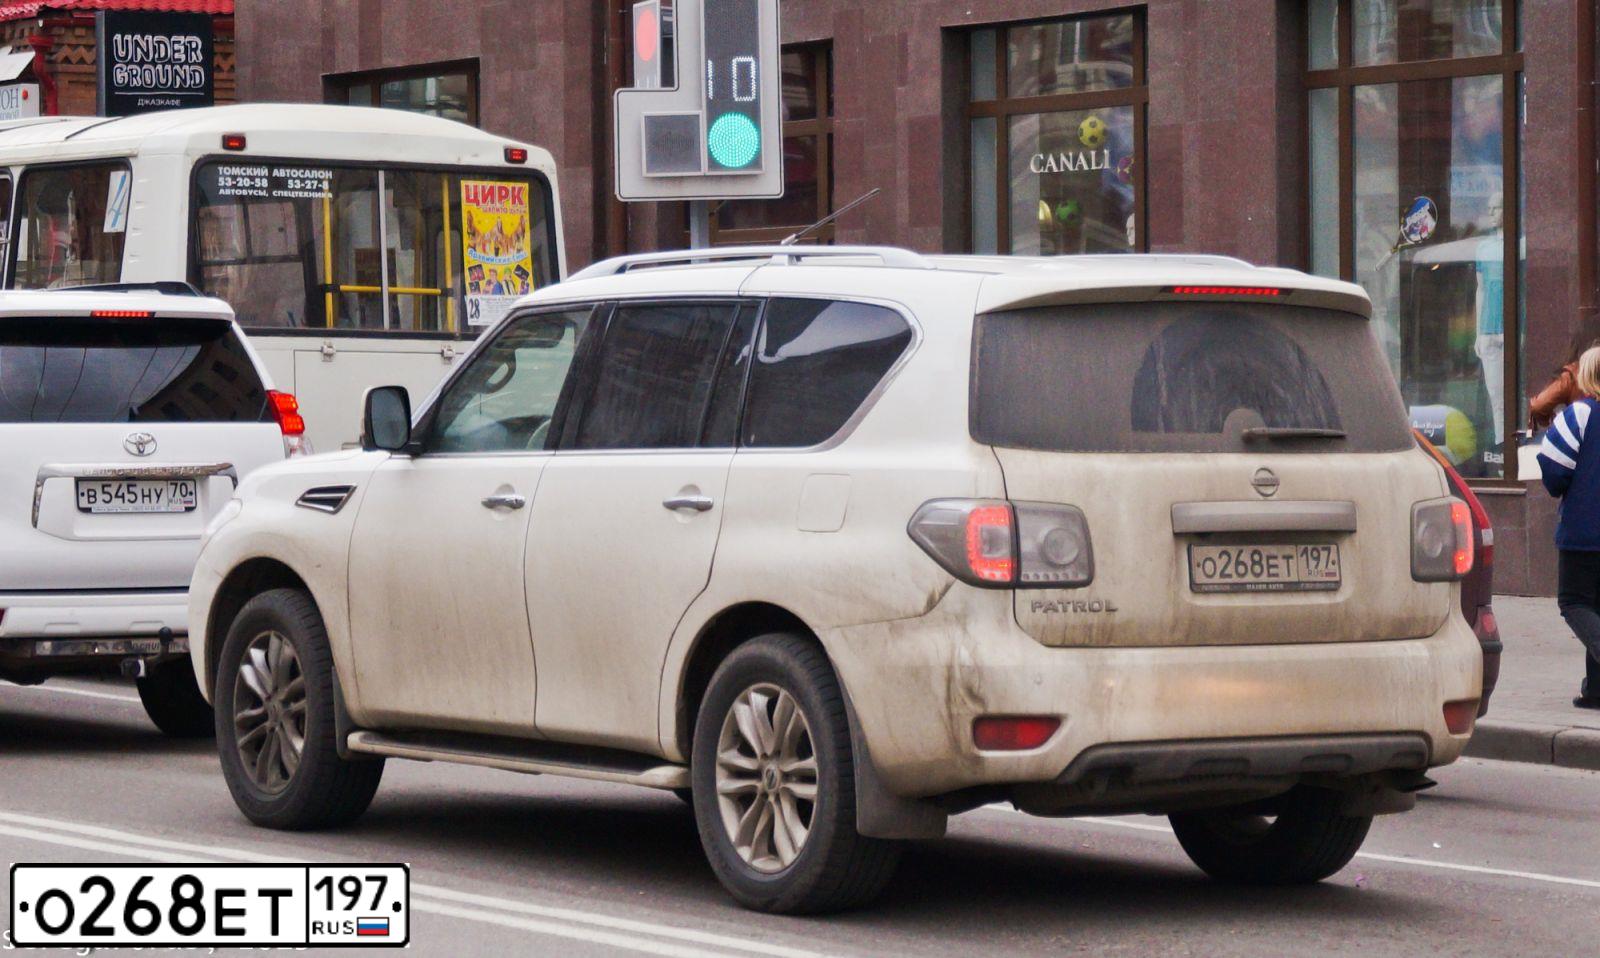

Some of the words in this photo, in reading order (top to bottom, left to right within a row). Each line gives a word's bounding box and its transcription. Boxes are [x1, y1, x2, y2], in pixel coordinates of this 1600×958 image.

[113, 33, 203, 63] UNDER
[113, 63, 205, 88] GROUND
[707, 56, 756, 102] 10
[137, 98, 181, 106] ДЖАЗКАФЕ
[1030, 148, 1111, 174] CANALI
[217, 166, 269, 177] ТОМСКИЙ
[272, 168, 333, 179] АВТОСАЛОН
[217, 177, 269, 188] 53-20-58
[218, 188, 269, 197] АВТОБУСЫ,
[464, 184, 525, 207] ЦИРК
[468, 298, 481, 319] 28
[86, 483, 163, 504] В545НУ
[169, 482, 188, 498] 70
[1202, 549, 1293, 579] О268ЕТ
[1300, 546, 1331, 569] 197
[1307, 569, 1324, 577] RUS
[1031, 599, 1118, 613] PATROL
